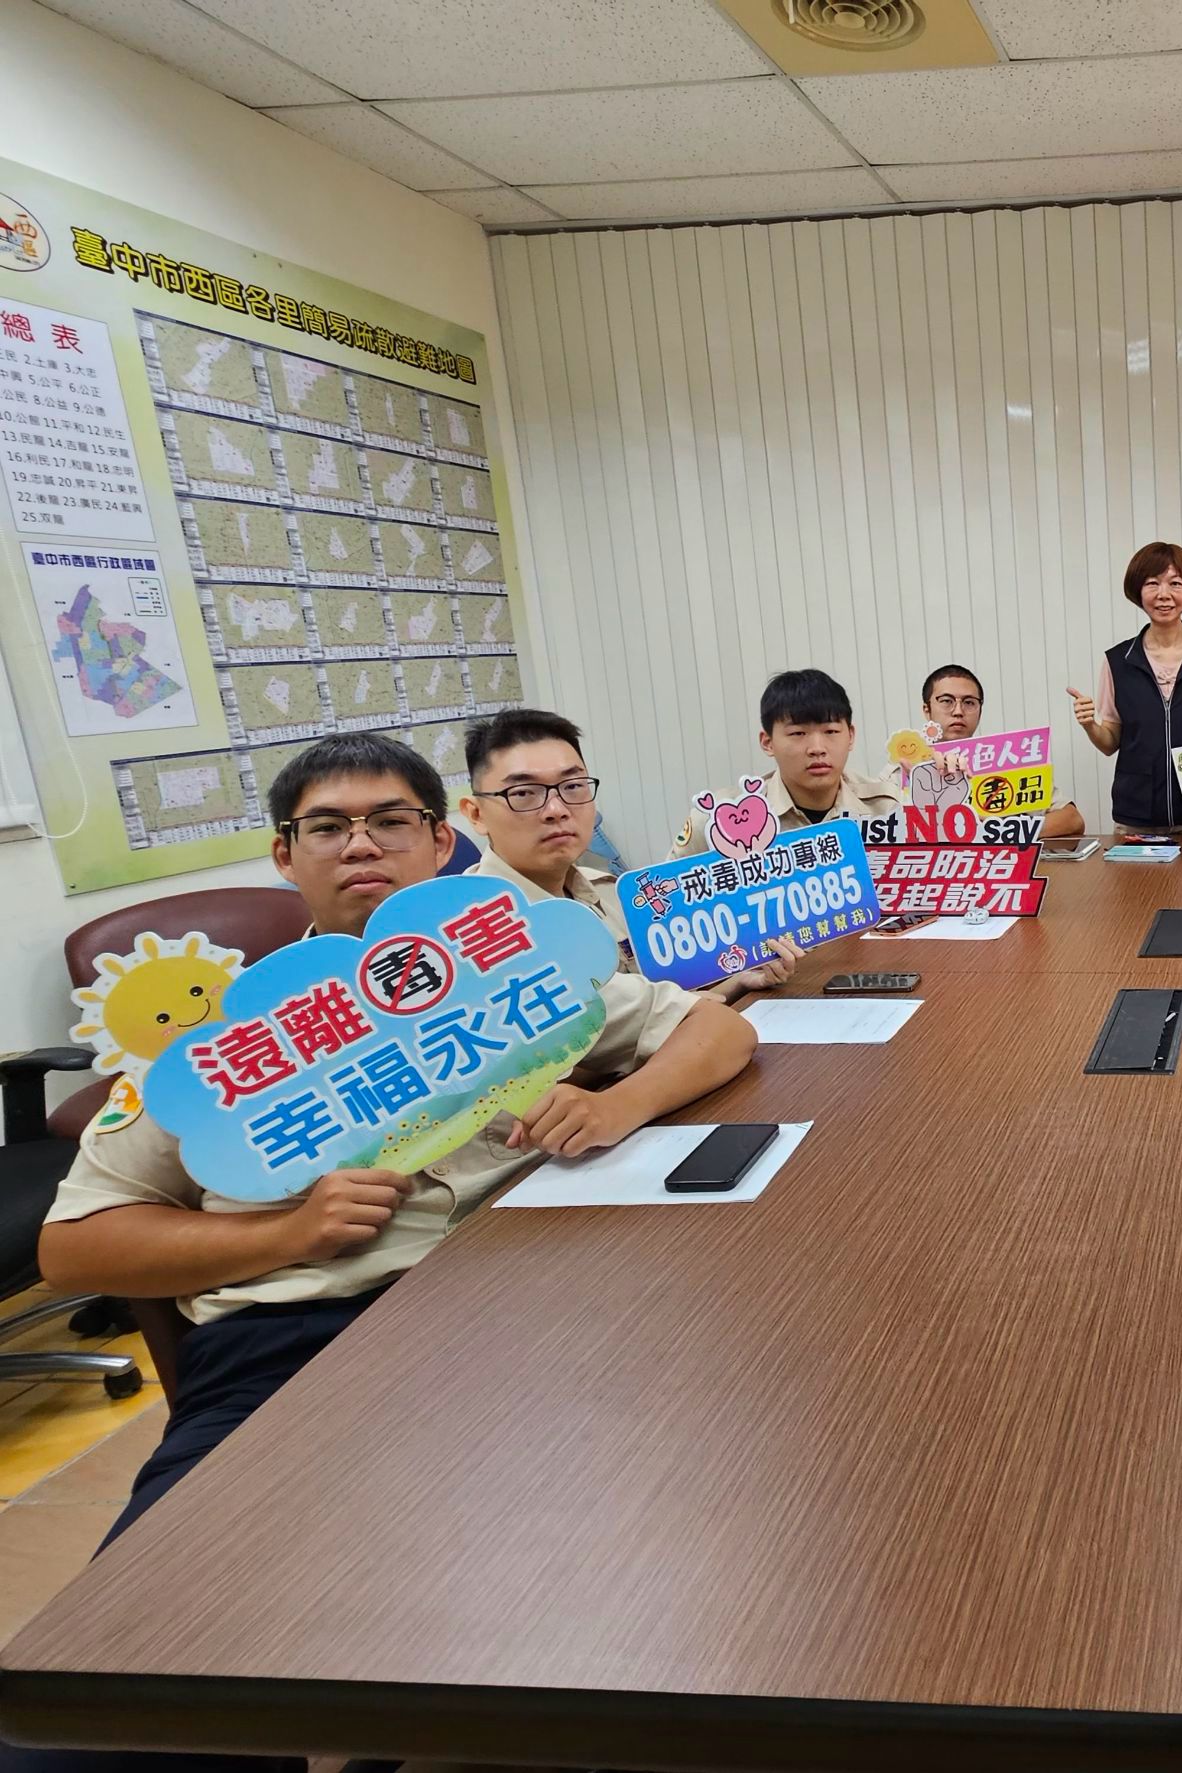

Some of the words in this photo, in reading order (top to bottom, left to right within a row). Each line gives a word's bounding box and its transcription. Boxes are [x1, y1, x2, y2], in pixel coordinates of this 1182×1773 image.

[70, 226, 477, 385] 臺中市西區各里簡易疏散避難地圖
[903, 804, 977, 844] NO
[983, 816, 1040, 850] say
[969, 775, 1044, 810] 毒品
[647, 865, 862, 967] 0800-770885
[681, 834, 842, 903] 戒毒成功專線
[190, 895, 534, 1107] 遠離毒害
[248, 966, 583, 1170] 幸福永在
